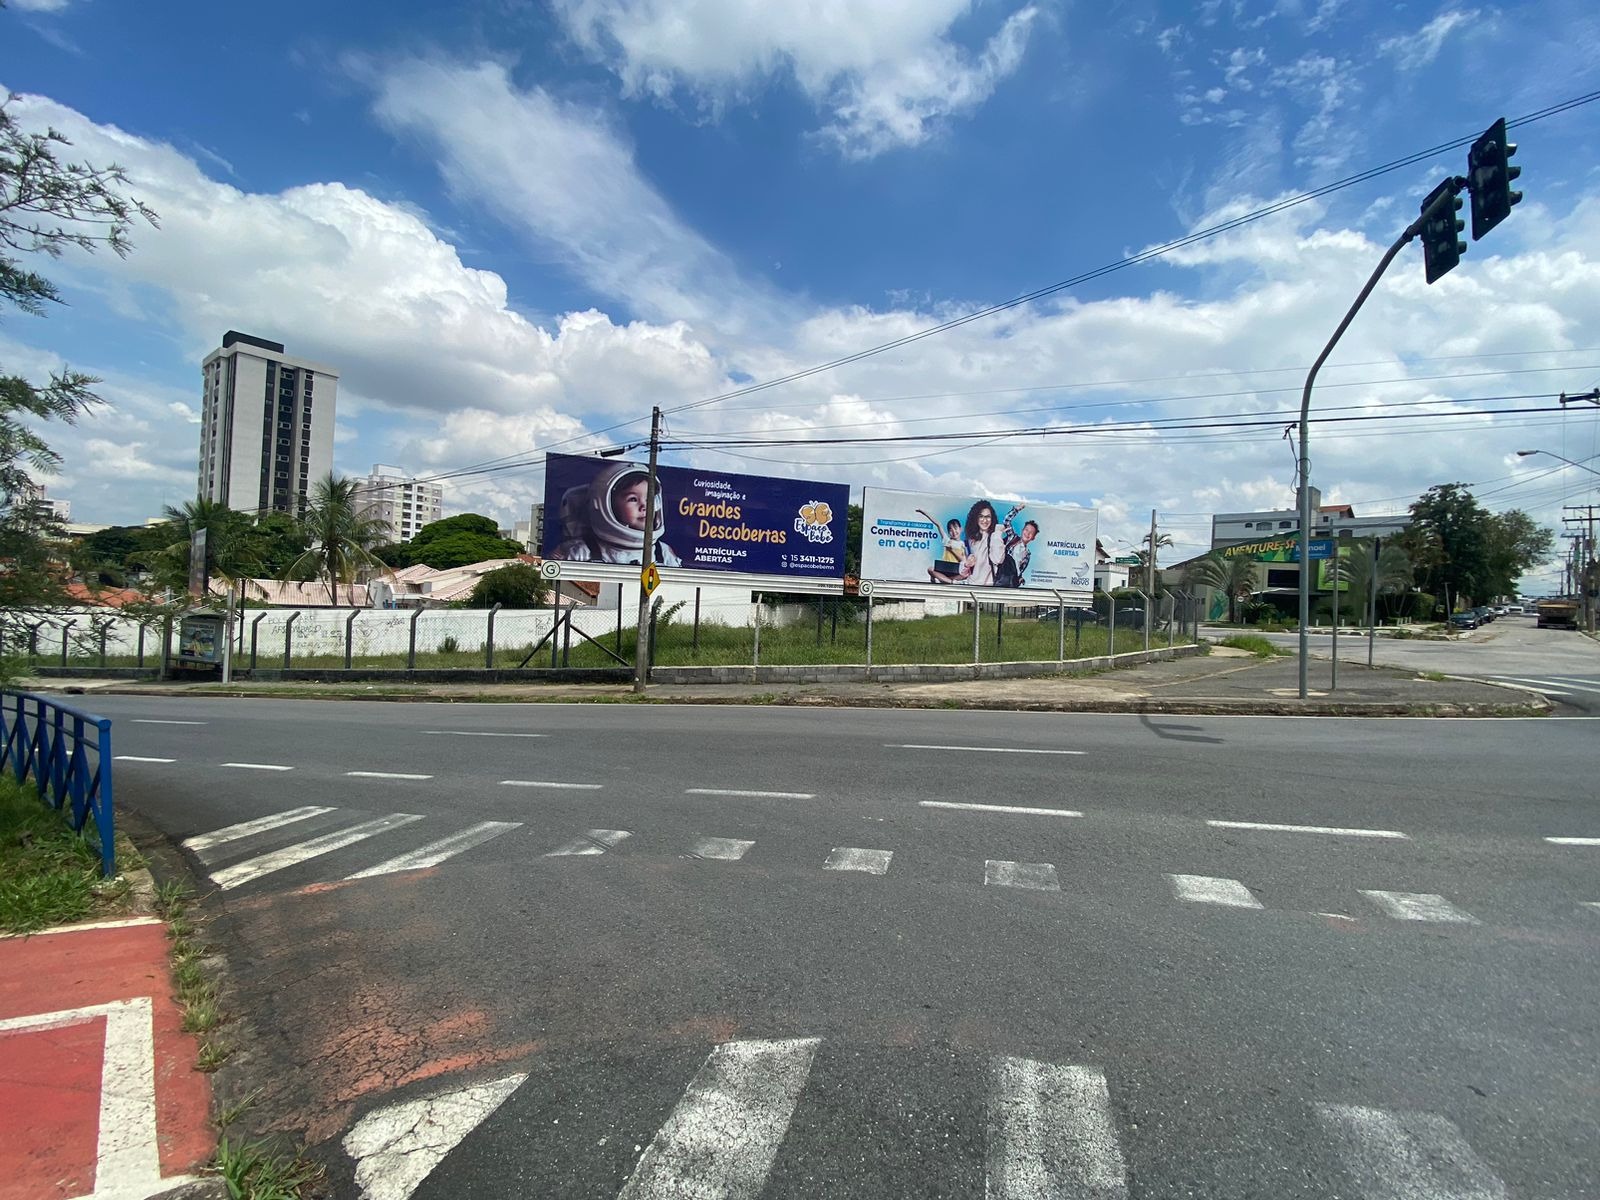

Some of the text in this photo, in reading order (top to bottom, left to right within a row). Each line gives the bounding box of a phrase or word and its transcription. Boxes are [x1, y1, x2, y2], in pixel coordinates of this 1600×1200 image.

[694, 479, 732, 490] Curiosidade,
[705, 490, 740, 501] imaginação
[679, 497, 741, 520] Grandes
[699, 520, 786, 544] Descobertas
[871, 526, 938, 539] Conhecimento
[878, 539, 930, 551] em ação!
[1047, 540, 1086, 550] MATRÍCULAS
[1295, 544, 1326, 552] Mnoel
[695, 546, 747, 557] MATRÍCULAS
[1054, 549, 1079, 557] ABERTAS
[695, 555, 733, 563] ABERTAS
[799, 555, 835, 564] 3411-1275
